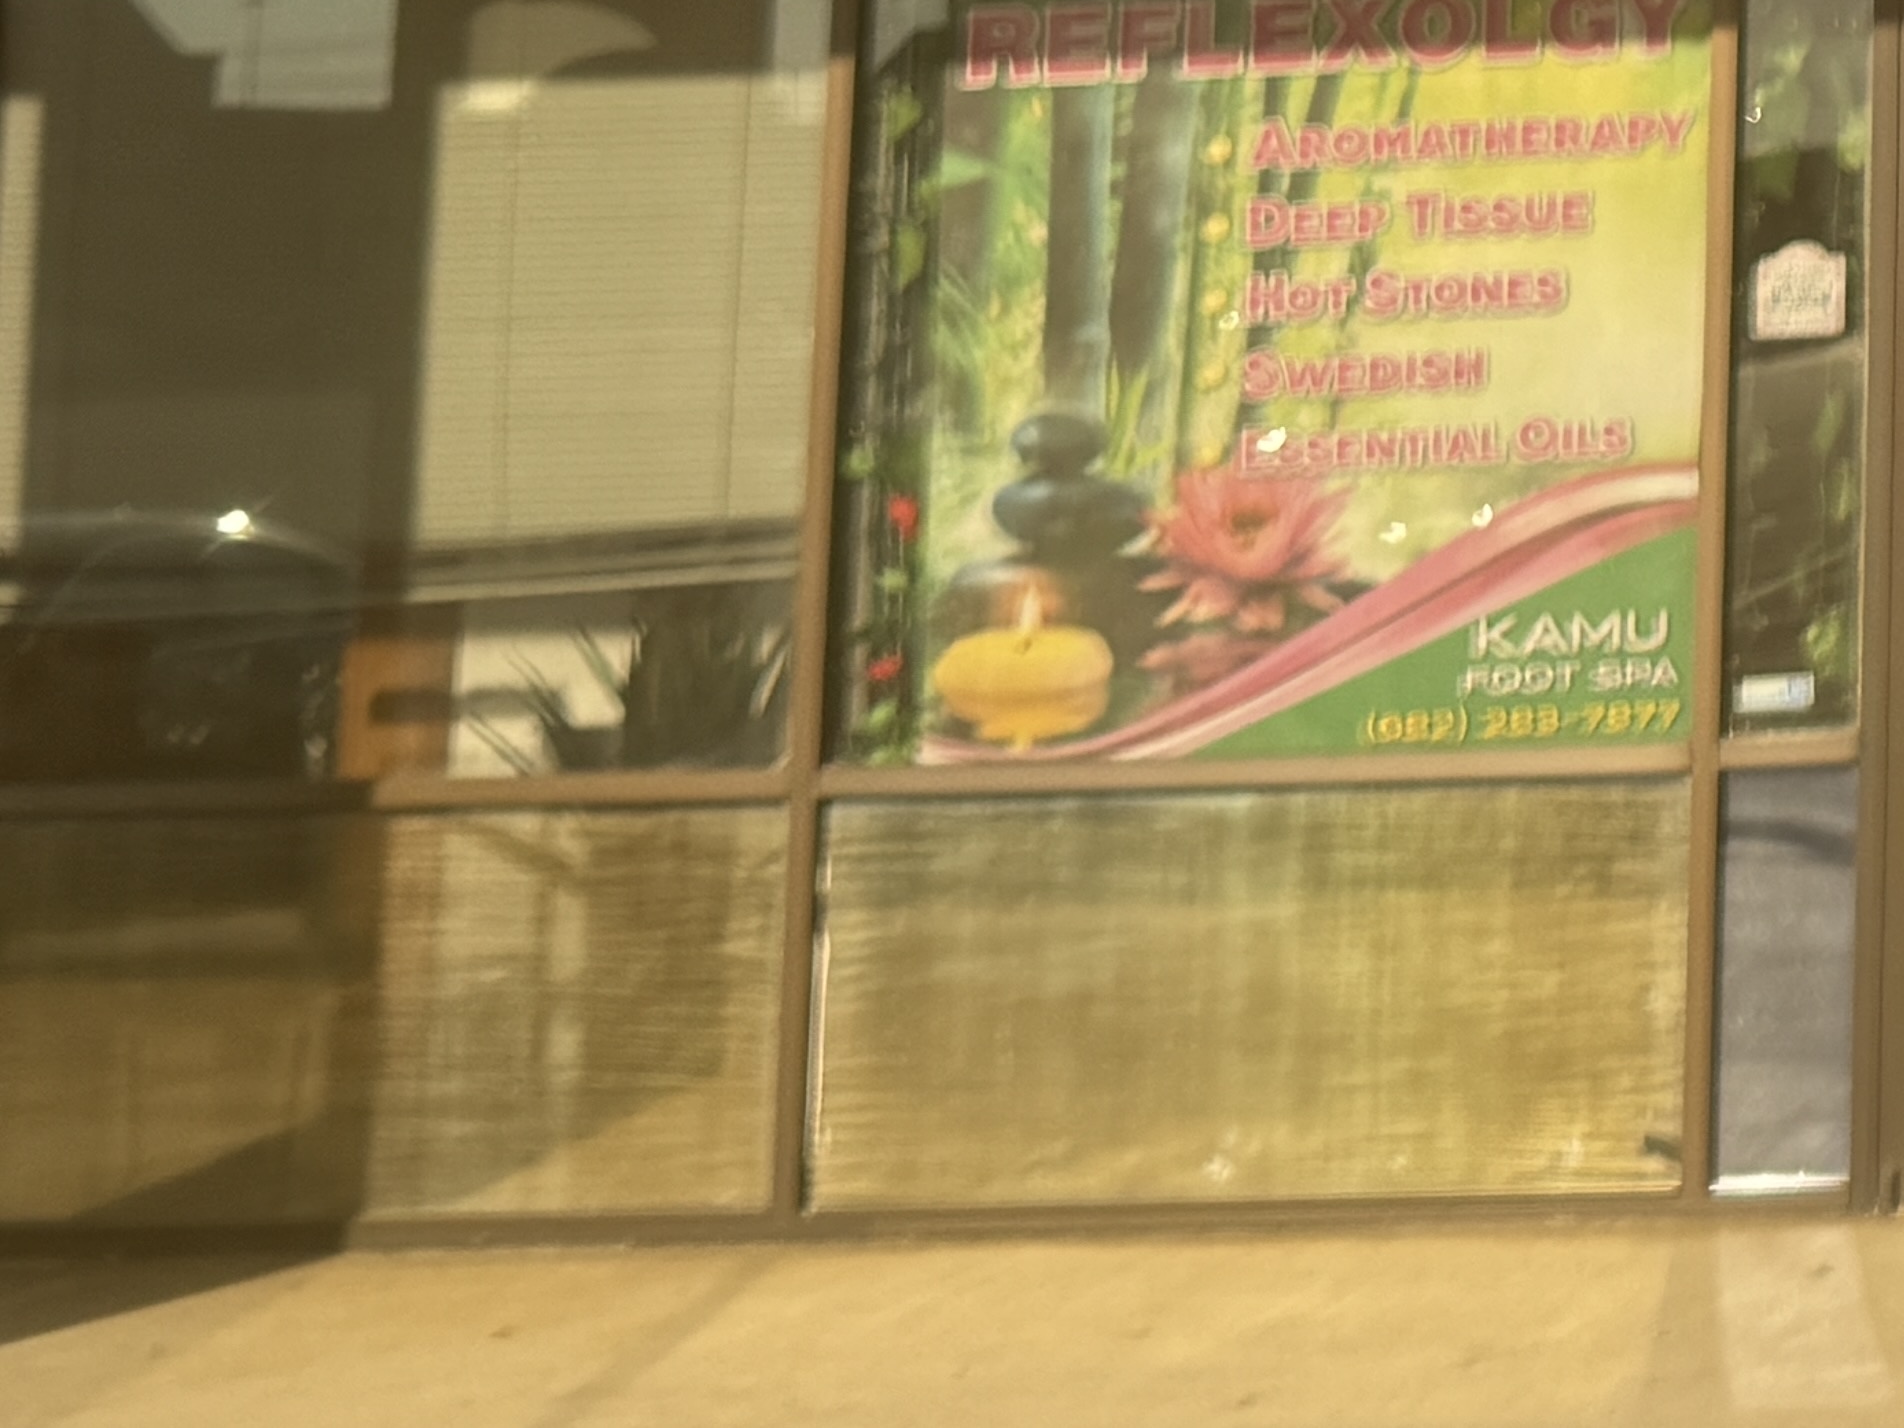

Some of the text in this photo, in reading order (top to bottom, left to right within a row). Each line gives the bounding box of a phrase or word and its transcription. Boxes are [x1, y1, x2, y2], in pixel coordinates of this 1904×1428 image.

[1251, 110, 1696, 171] AROMATHERAPY
[1245, 188, 1595, 249] DEEP TISSUE
[1244, 266, 1569, 323] HOT STONES
[1243, 347, 1490, 399] SWEDISH
[1515, 414, 1634, 461] OILS
[1467, 606, 1669, 660] KAMU
[1458, 656, 1679, 697] FOOT SPA
